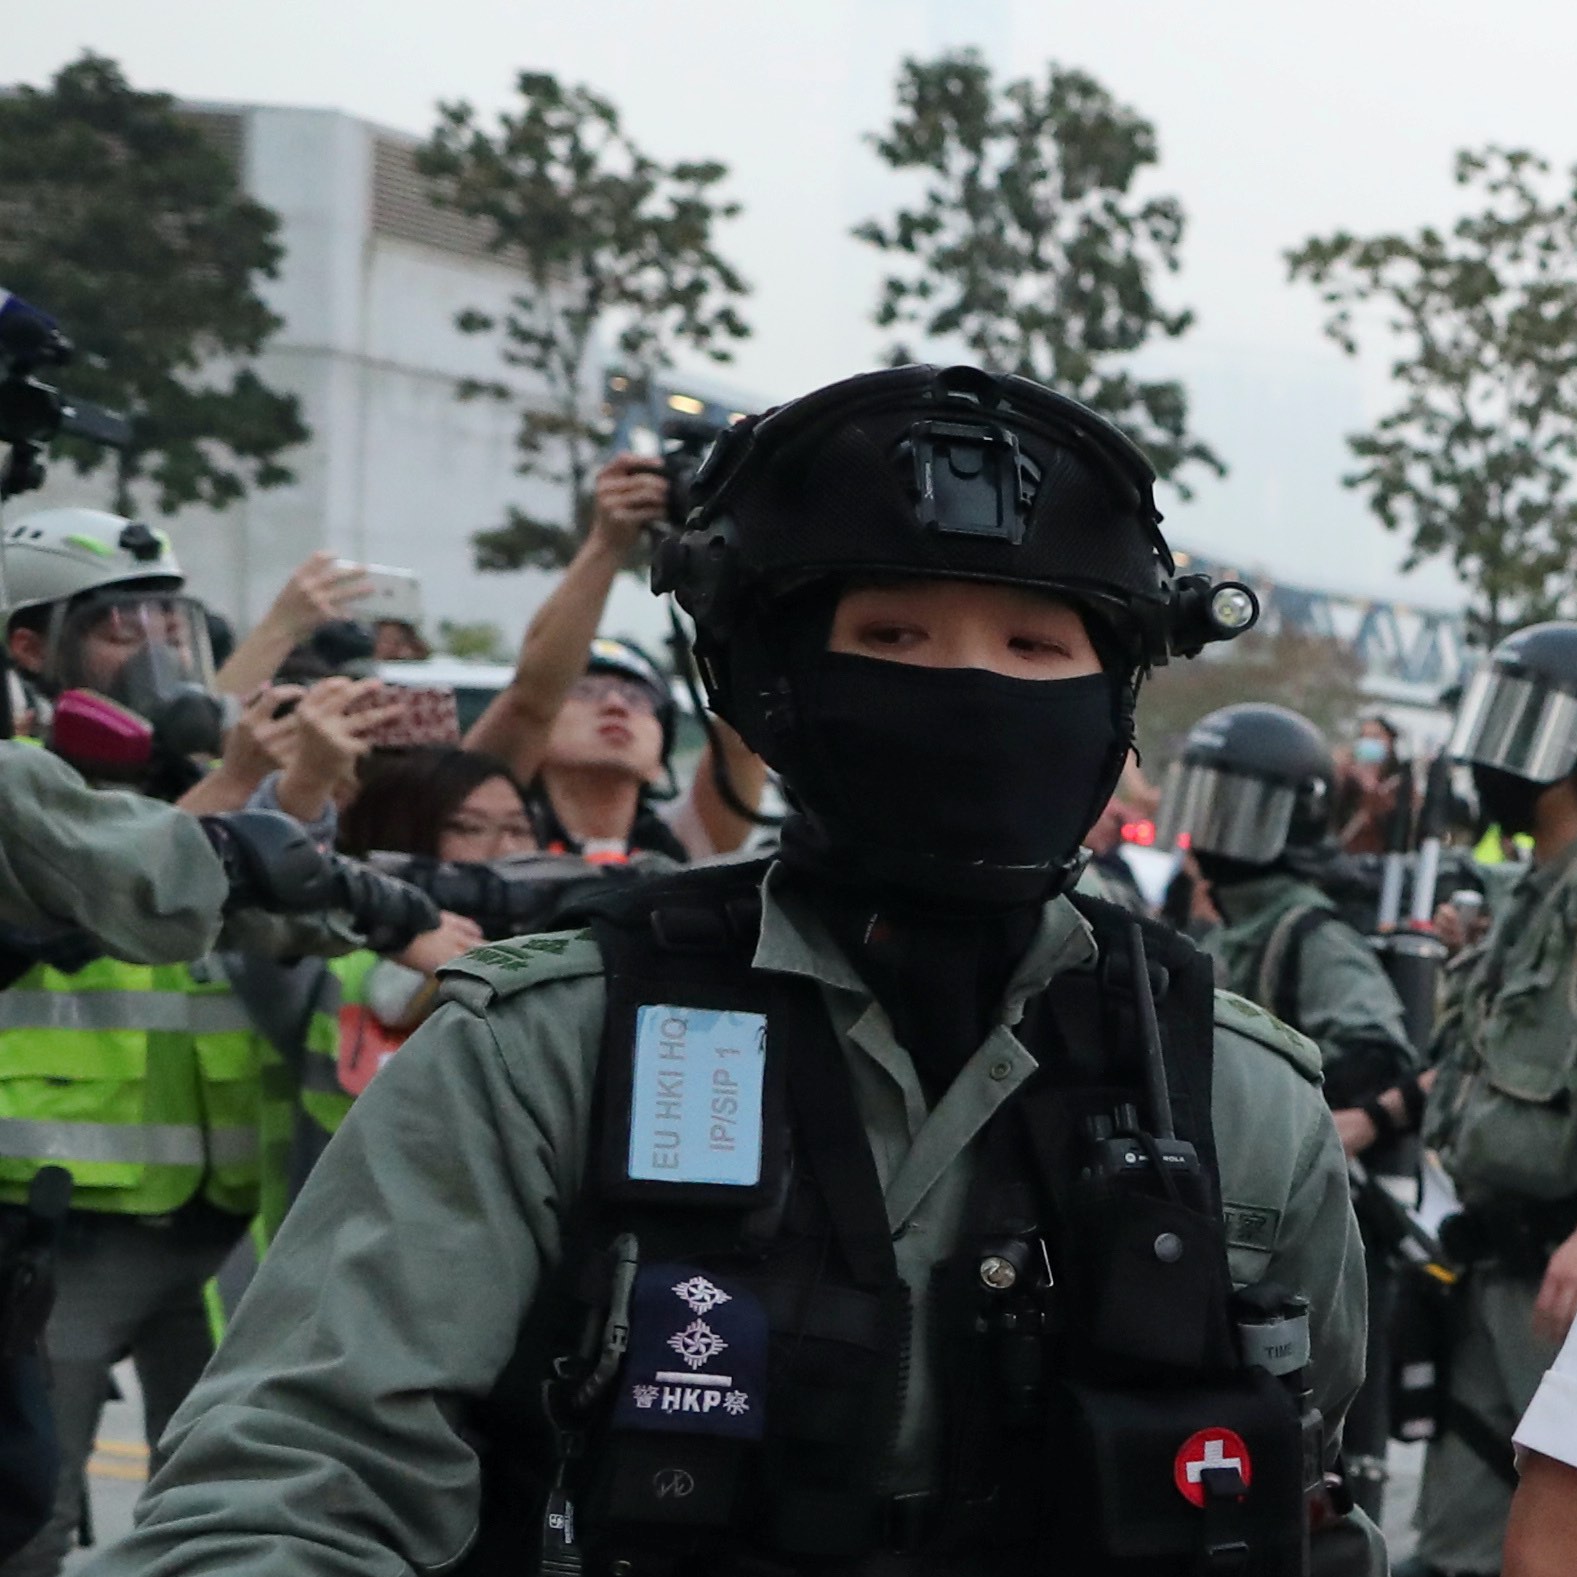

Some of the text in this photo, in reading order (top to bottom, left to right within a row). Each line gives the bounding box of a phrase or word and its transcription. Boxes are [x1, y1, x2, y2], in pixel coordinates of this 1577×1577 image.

[653, 1017, 689, 1169] EU HKI HQ
[709, 1067, 739, 1152] IP/SIP
